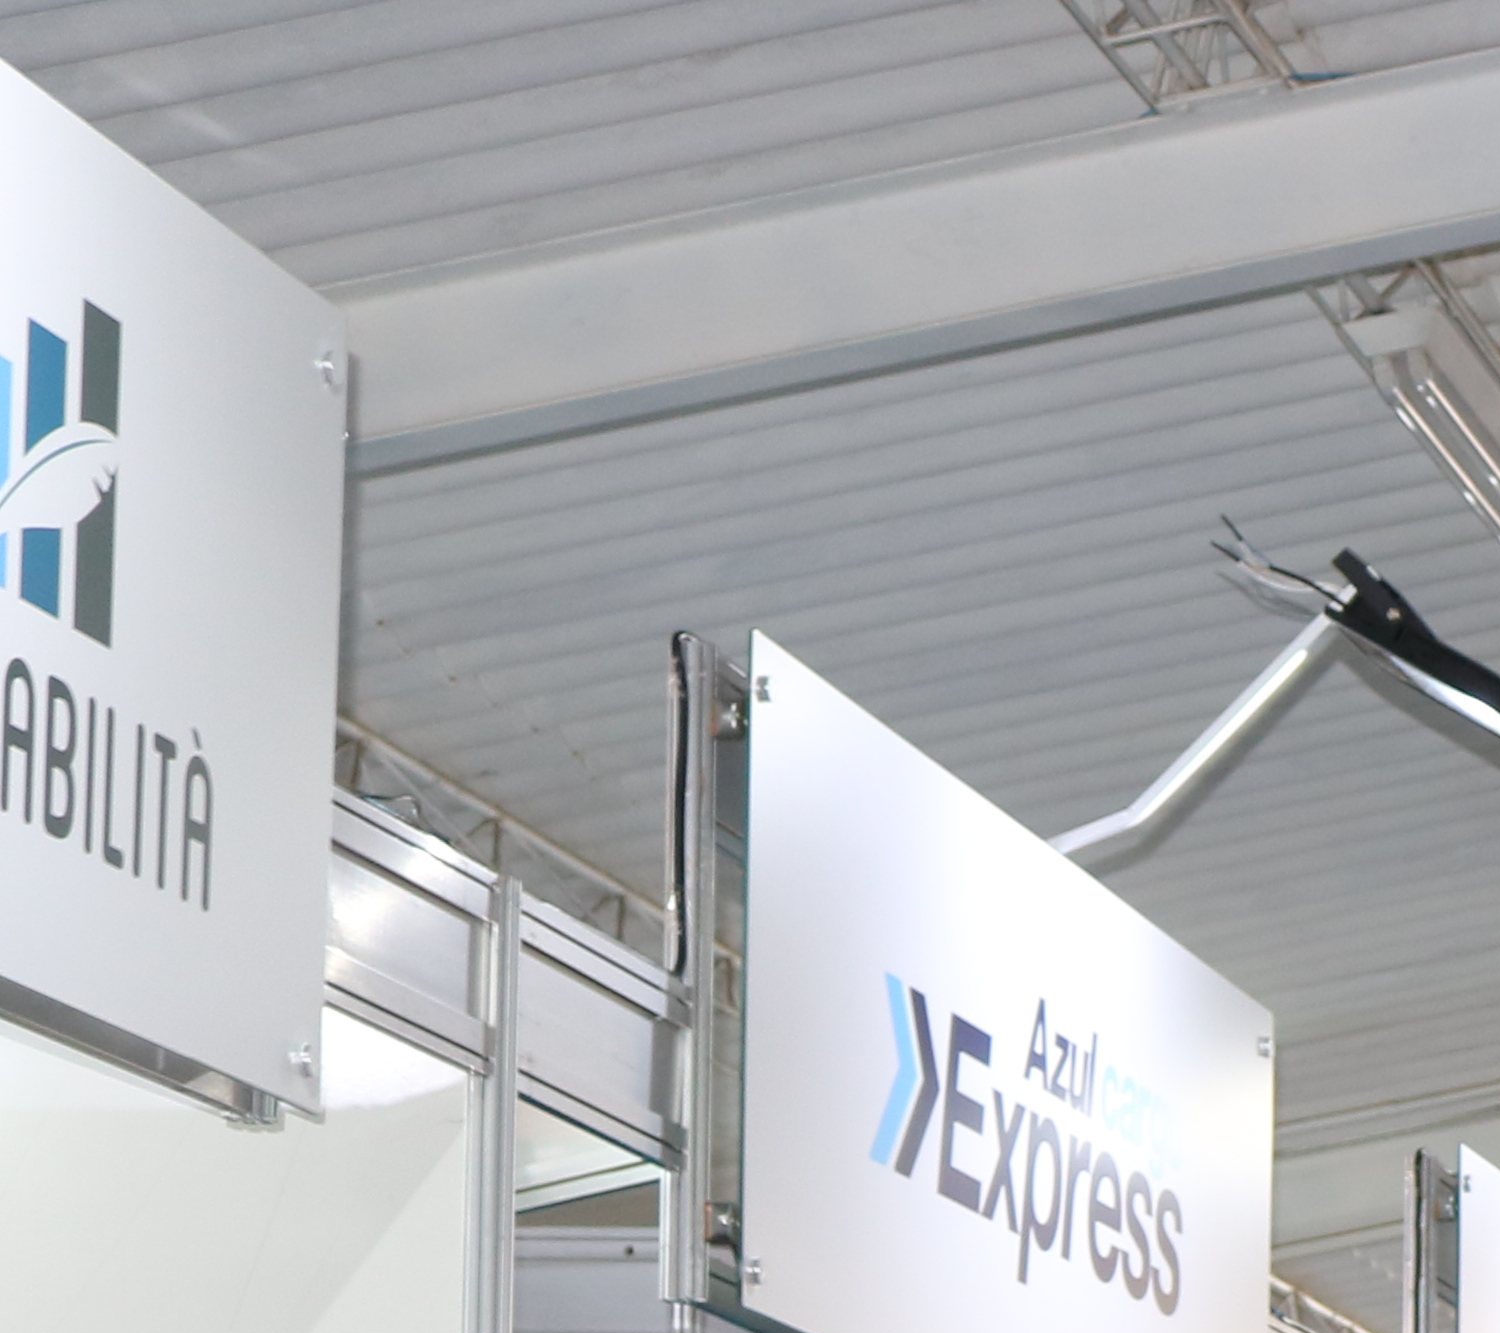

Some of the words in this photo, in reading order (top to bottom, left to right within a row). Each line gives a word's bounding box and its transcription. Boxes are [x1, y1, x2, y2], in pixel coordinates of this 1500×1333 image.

[1, 657, 213, 912] ABILITÀ
[937, 1012, 1183, 1317] Express
[1025, 997, 1098, 1119] Azul
